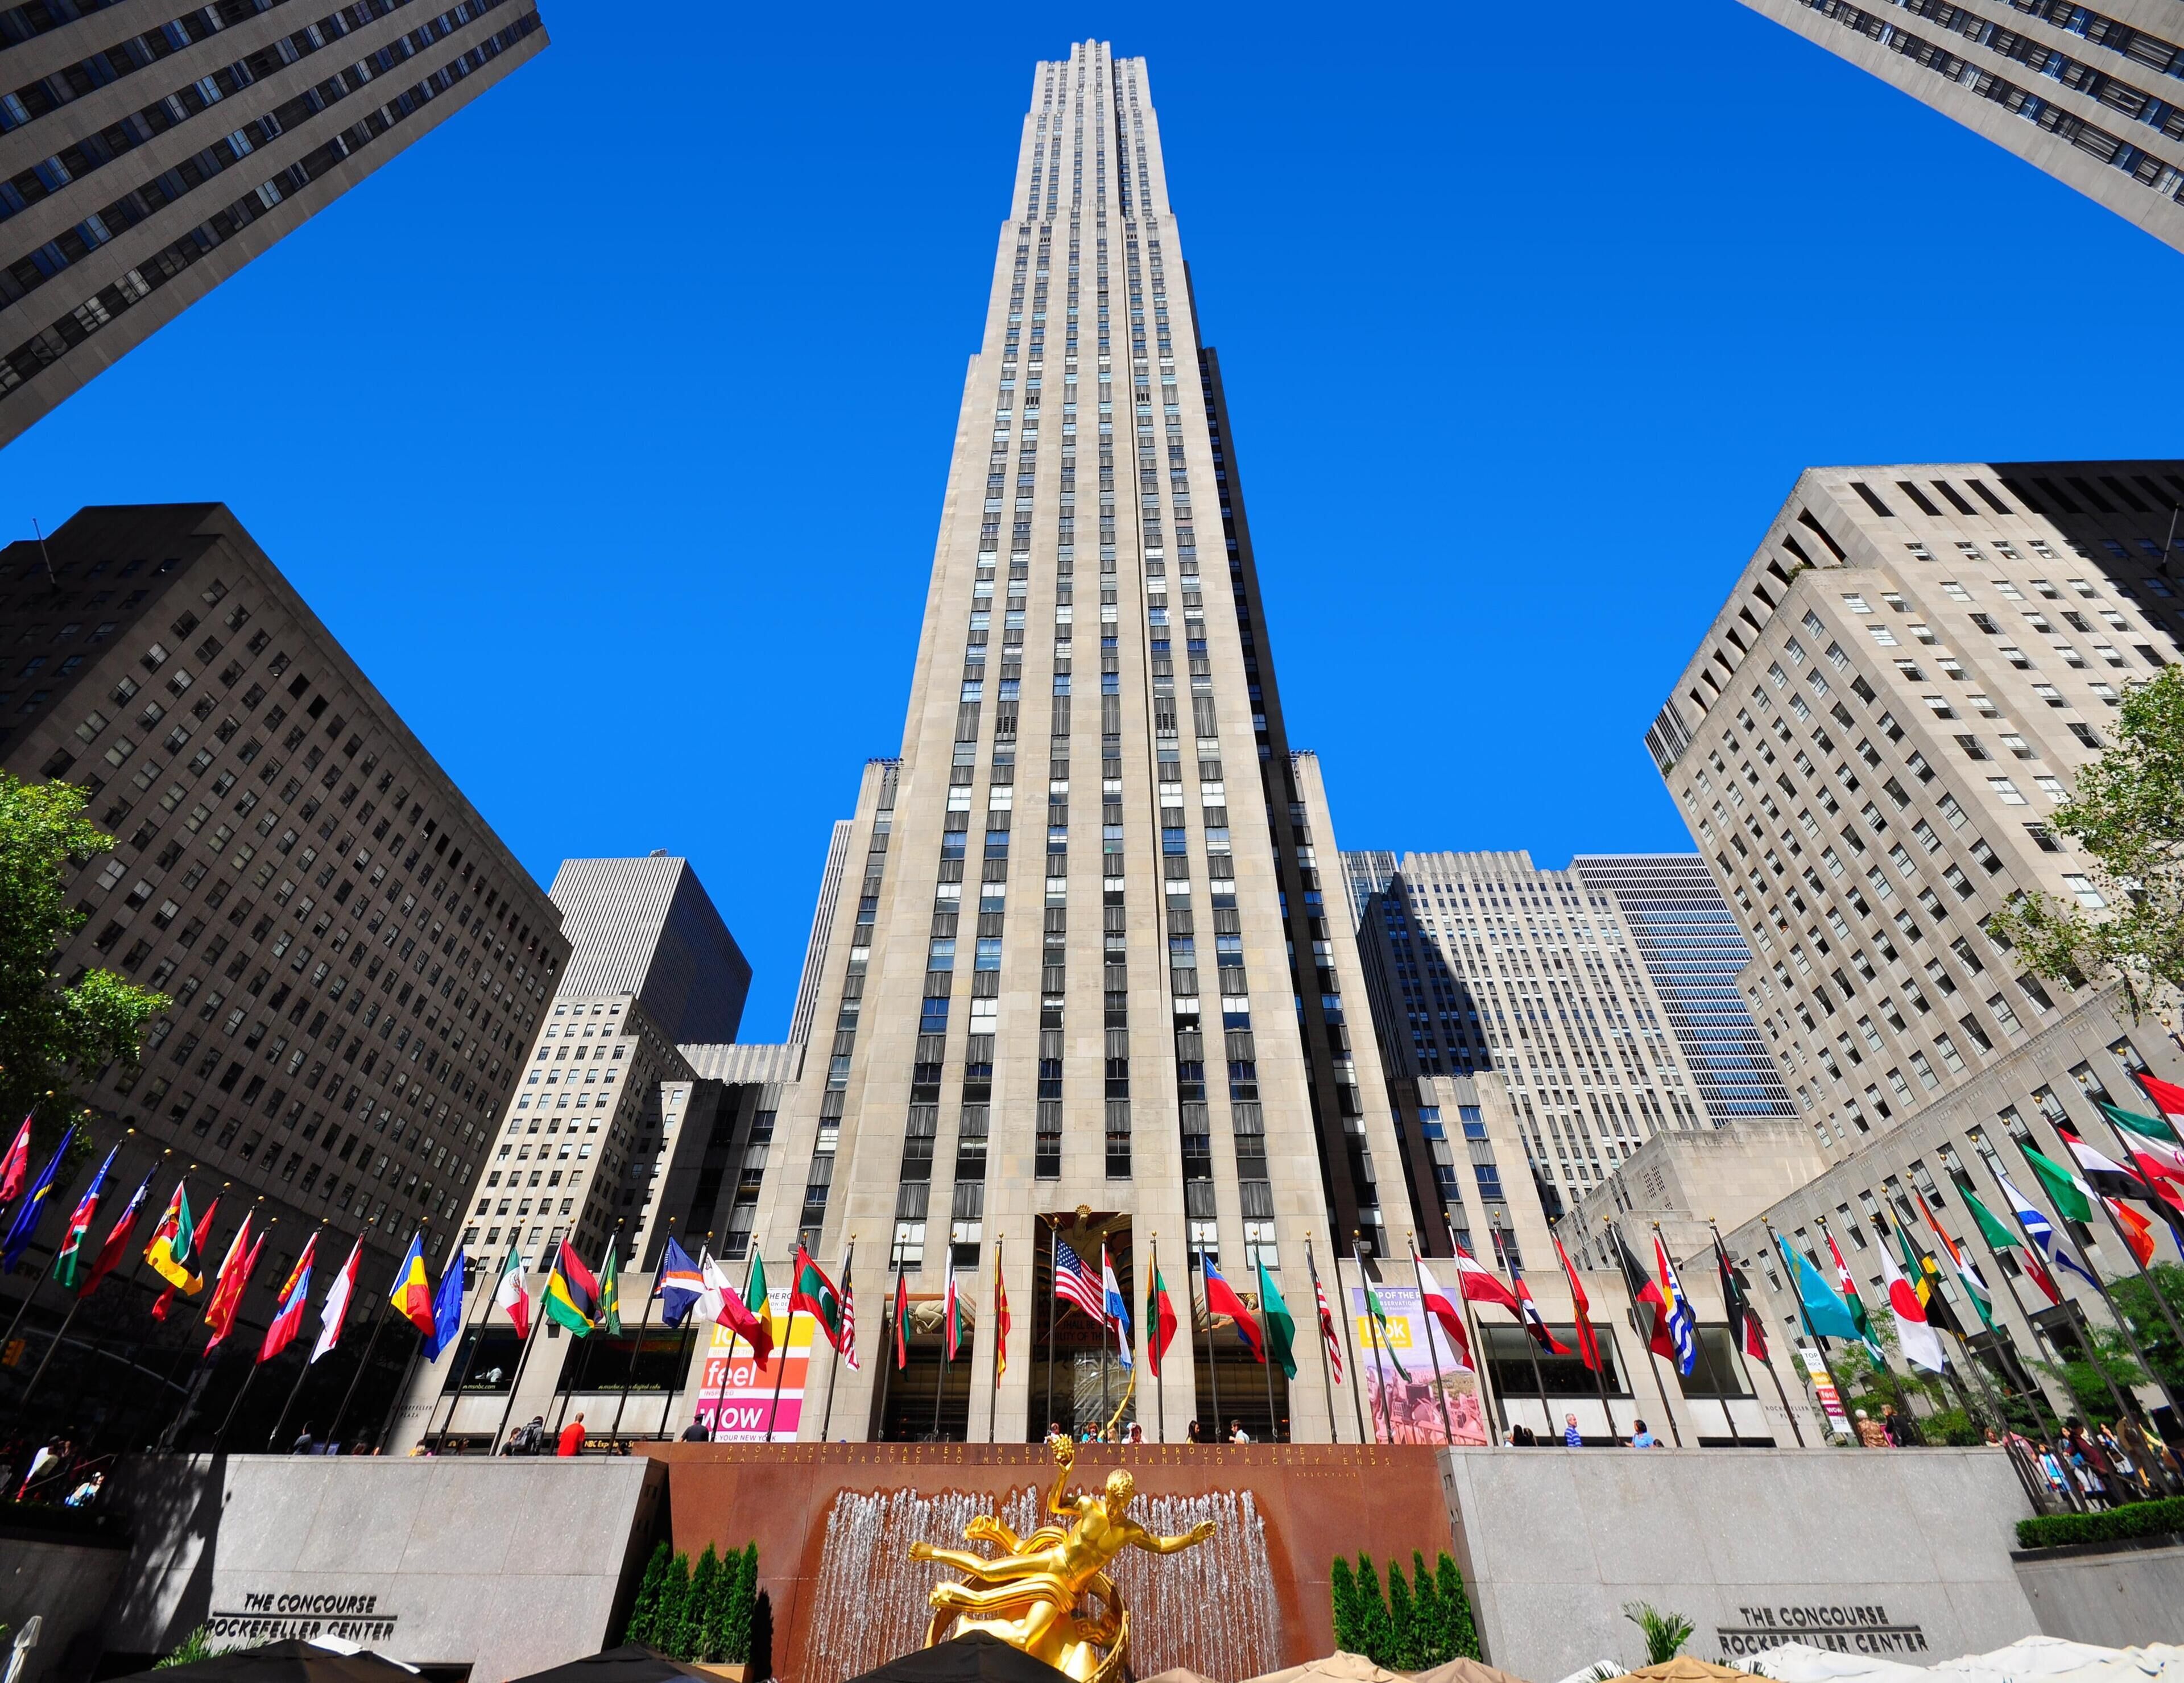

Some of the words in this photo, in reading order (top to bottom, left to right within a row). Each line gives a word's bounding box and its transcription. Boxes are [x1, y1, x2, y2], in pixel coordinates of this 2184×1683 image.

[707, 1361, 758, 1387] feel
[847, 1455, 920, 1464] PROVED
[1244, 1457, 1321, 1466] MIGHTY
[1343, 1457, 1391, 1466] ENDS
[876, 1446, 962, 1454] TEACHER
[244, 1593, 275, 1612] THE
[277, 1594, 377, 1614] CONCOURSE
[1738, 1606, 1776, 1627] THE
[1780, 1606, 1890, 1627] CONCOURSE
[206, 1618, 321, 1639] ROCKEFELLER
[327, 1622, 395, 1641] CENTER
[1856, 1633, 1930, 1653] CENTER
